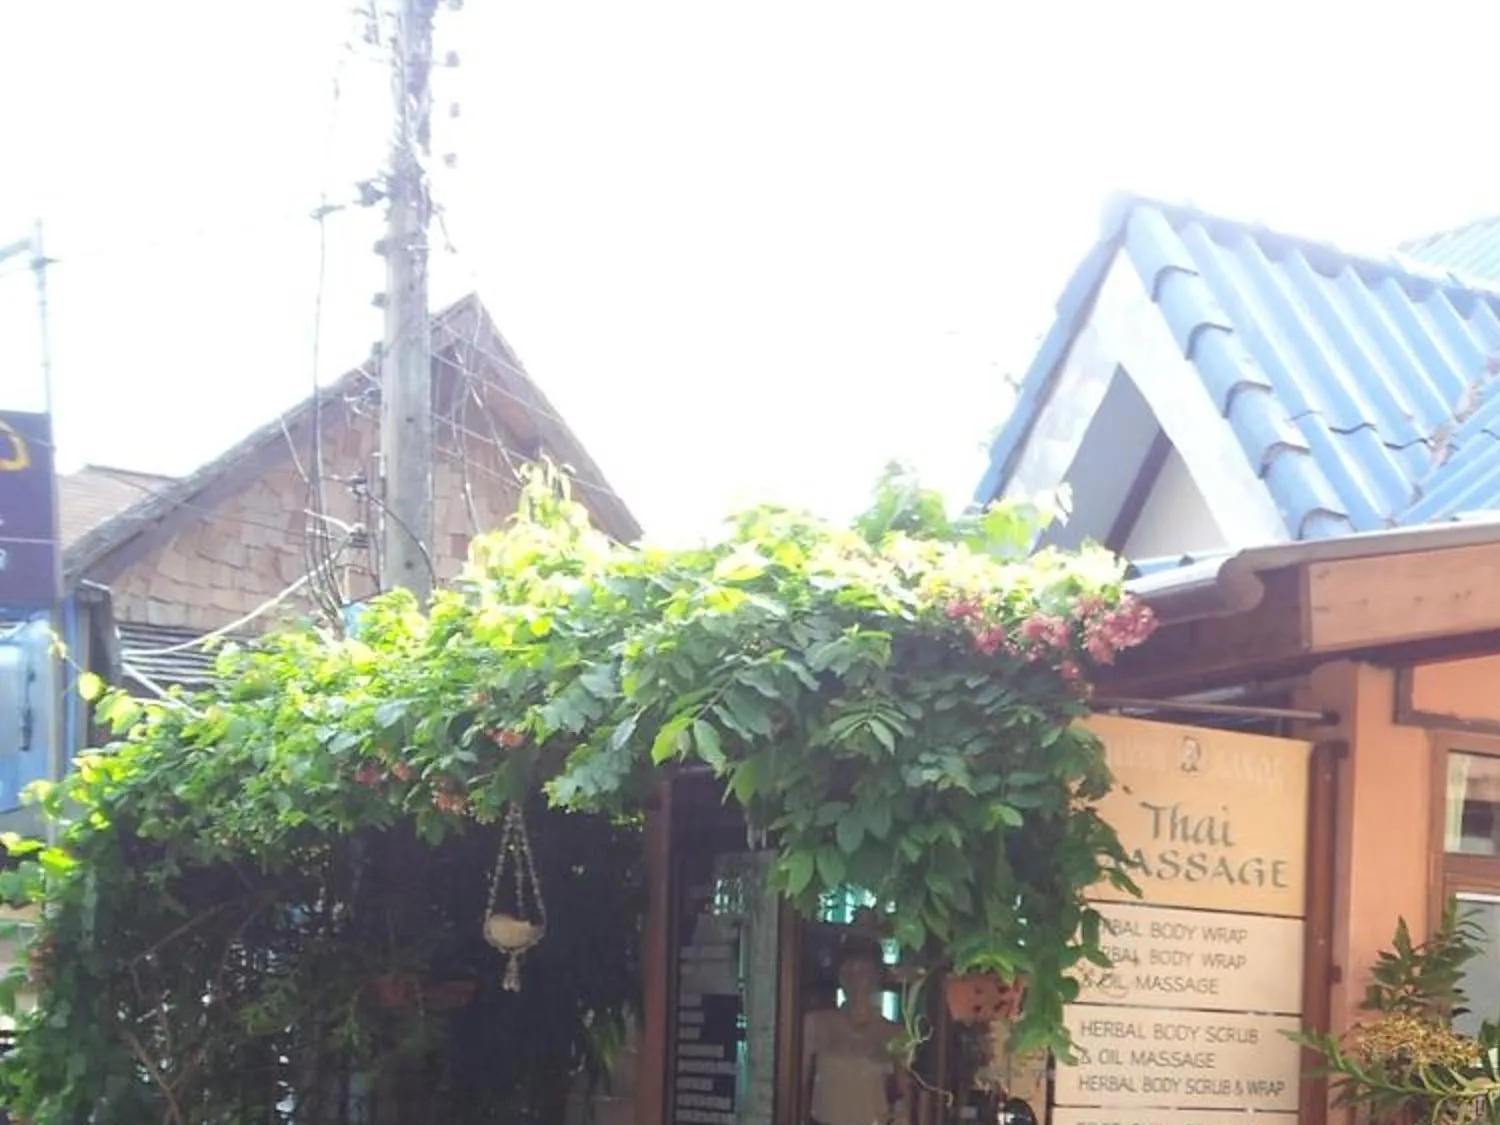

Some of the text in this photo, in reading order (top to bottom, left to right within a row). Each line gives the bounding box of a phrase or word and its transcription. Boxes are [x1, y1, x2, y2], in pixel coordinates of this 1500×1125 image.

[1139, 800, 1237, 848] Thai
[1122, 847, 1290, 889] ASSAGE
[1151, 921, 1200, 941] BODY
[1203, 927, 1248, 944] WRAP
[1150, 948, 1198, 966] BODY
[1203, 952, 1247, 970] WRAP
[1136, 974, 1220, 996] MASSAGE
[1080, 1020, 1259, 1045] HERBAL BODY SCRUB
[1080, 1048, 1216, 1070] & OIL MASSAGE
[1079, 1075, 1138, 1093] HERBAL
[1143, 1077, 1184, 1094] BODY
